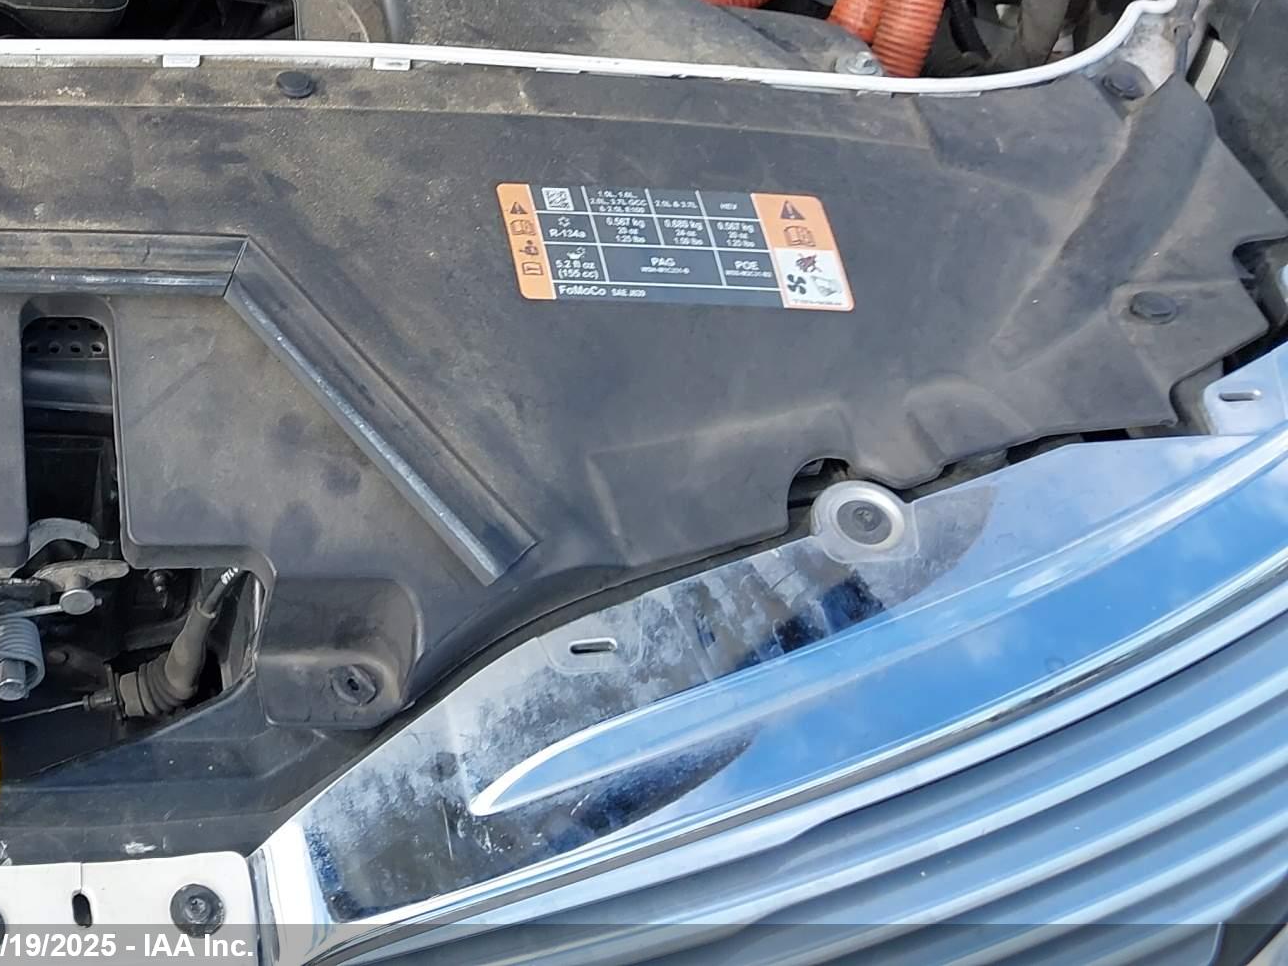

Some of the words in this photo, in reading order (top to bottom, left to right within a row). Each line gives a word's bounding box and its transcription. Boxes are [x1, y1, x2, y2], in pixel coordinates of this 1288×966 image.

[632, 217, 646, 228] kg
[548, 228, 587, 239] R-134a
[555, 259, 572, 268] 5.2
[650, 257, 676, 267] PAG
[734, 260, 759, 270] POE
[558, 285, 607, 296] FoMoCo
